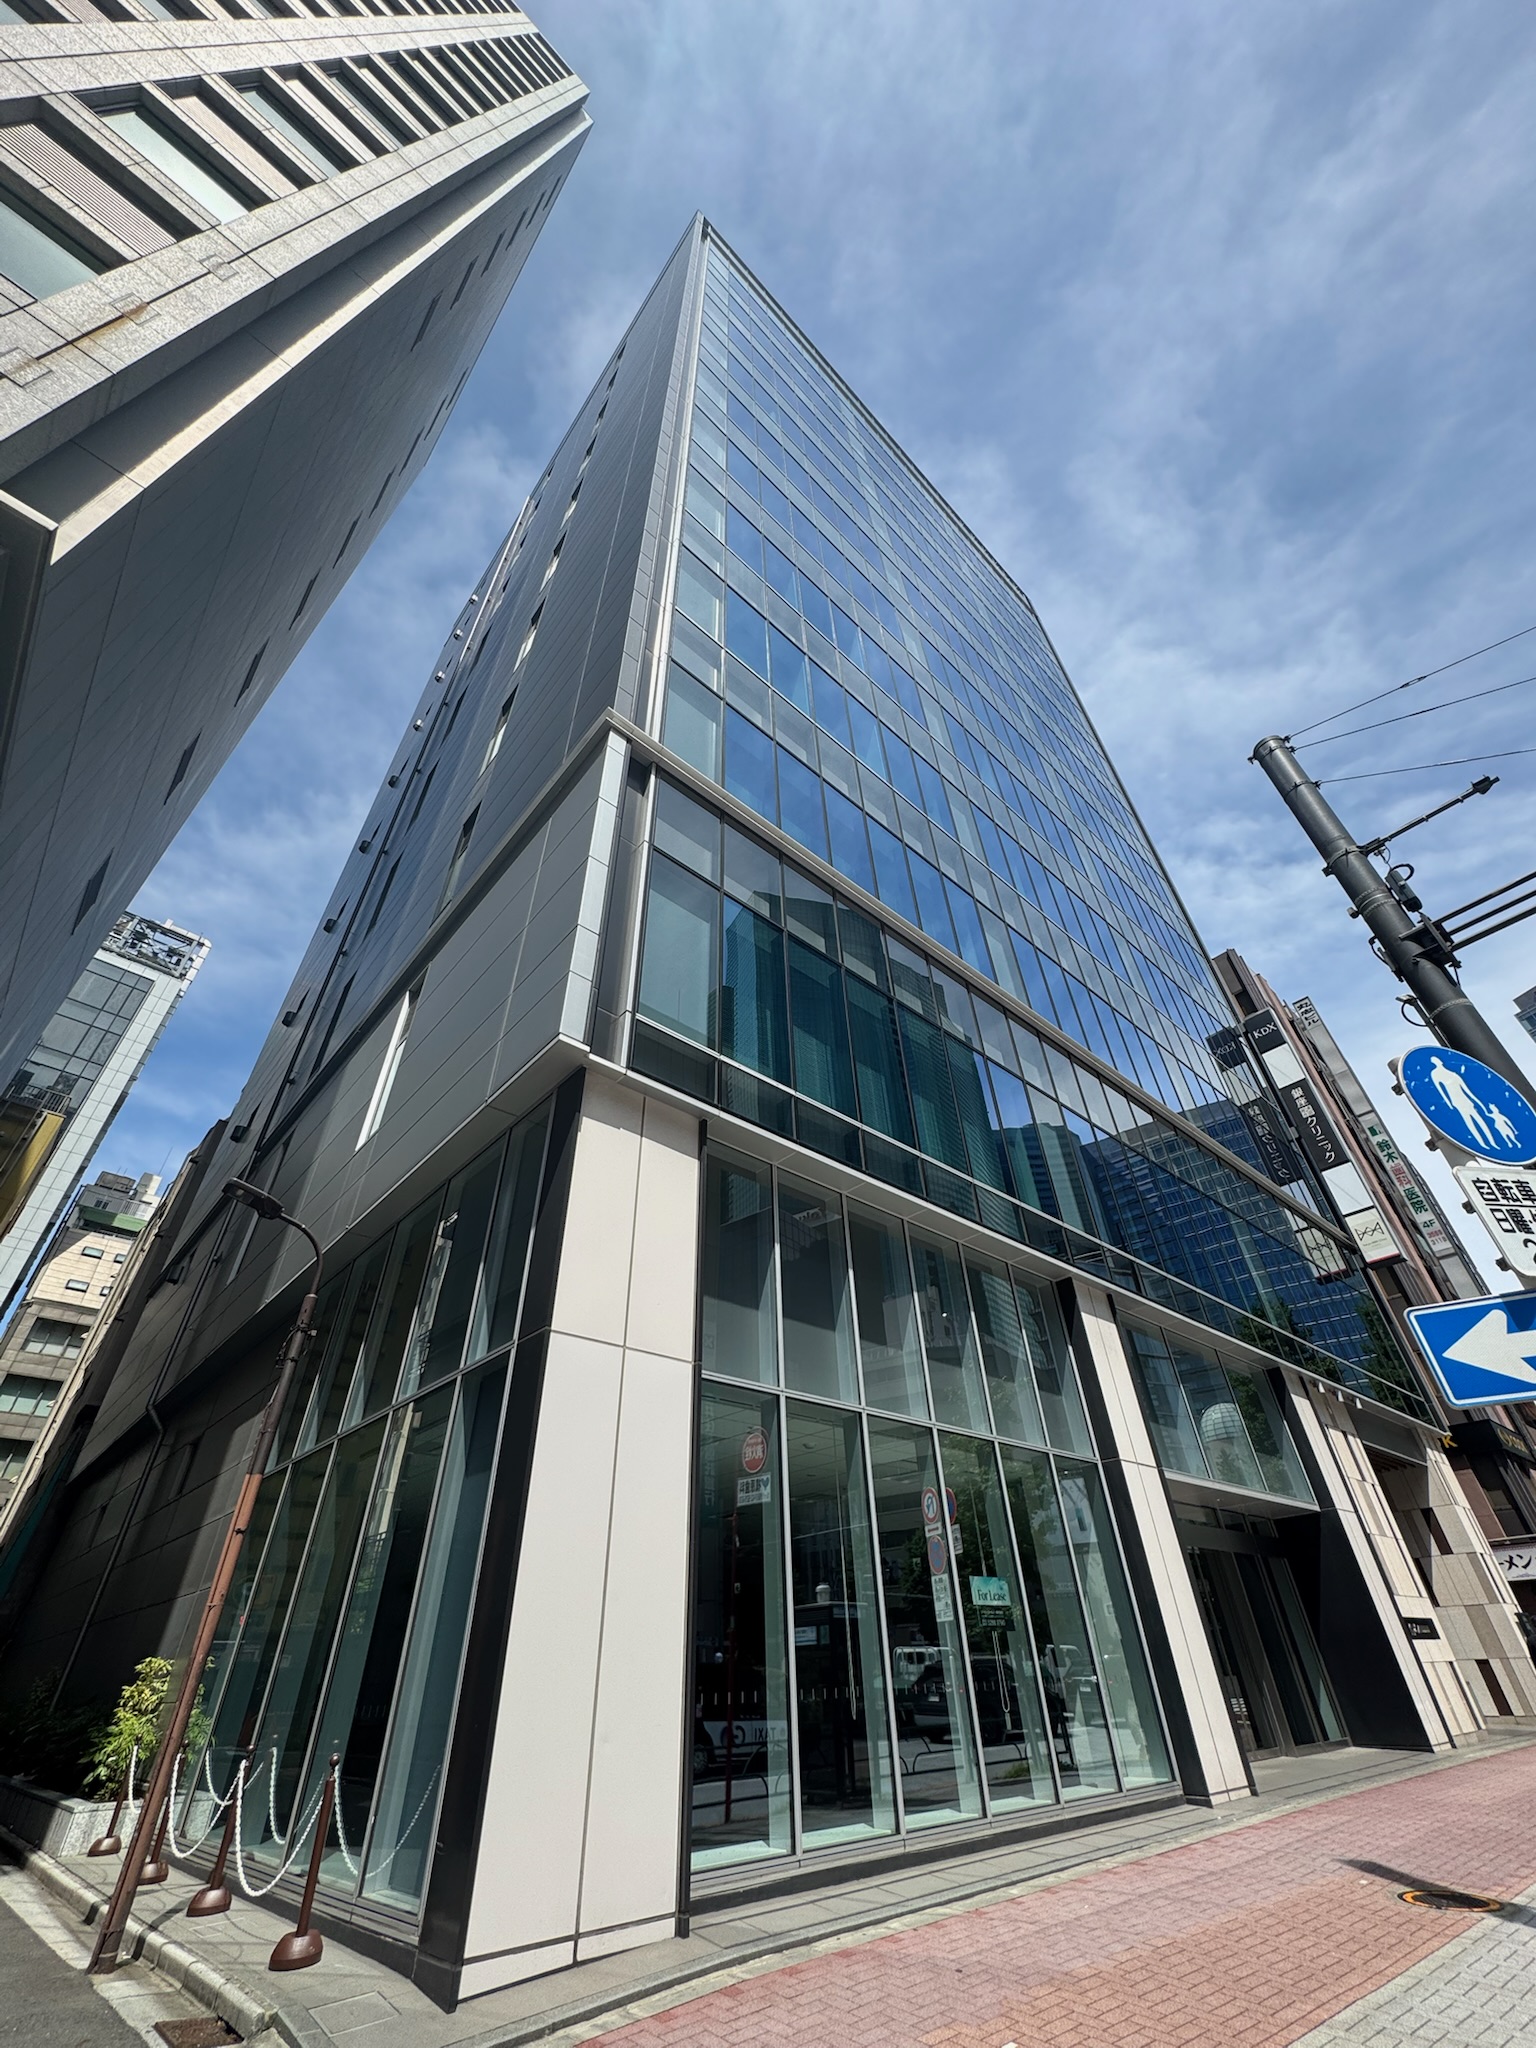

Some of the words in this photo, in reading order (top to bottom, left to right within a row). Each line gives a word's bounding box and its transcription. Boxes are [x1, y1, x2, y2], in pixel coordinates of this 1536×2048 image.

[1253, 1022, 1277, 1039] KDX
[1423, 1219, 1436, 1229] 4F
[977, 1589, 988, 1601] For
[989, 1589, 1007, 1602] Lease
